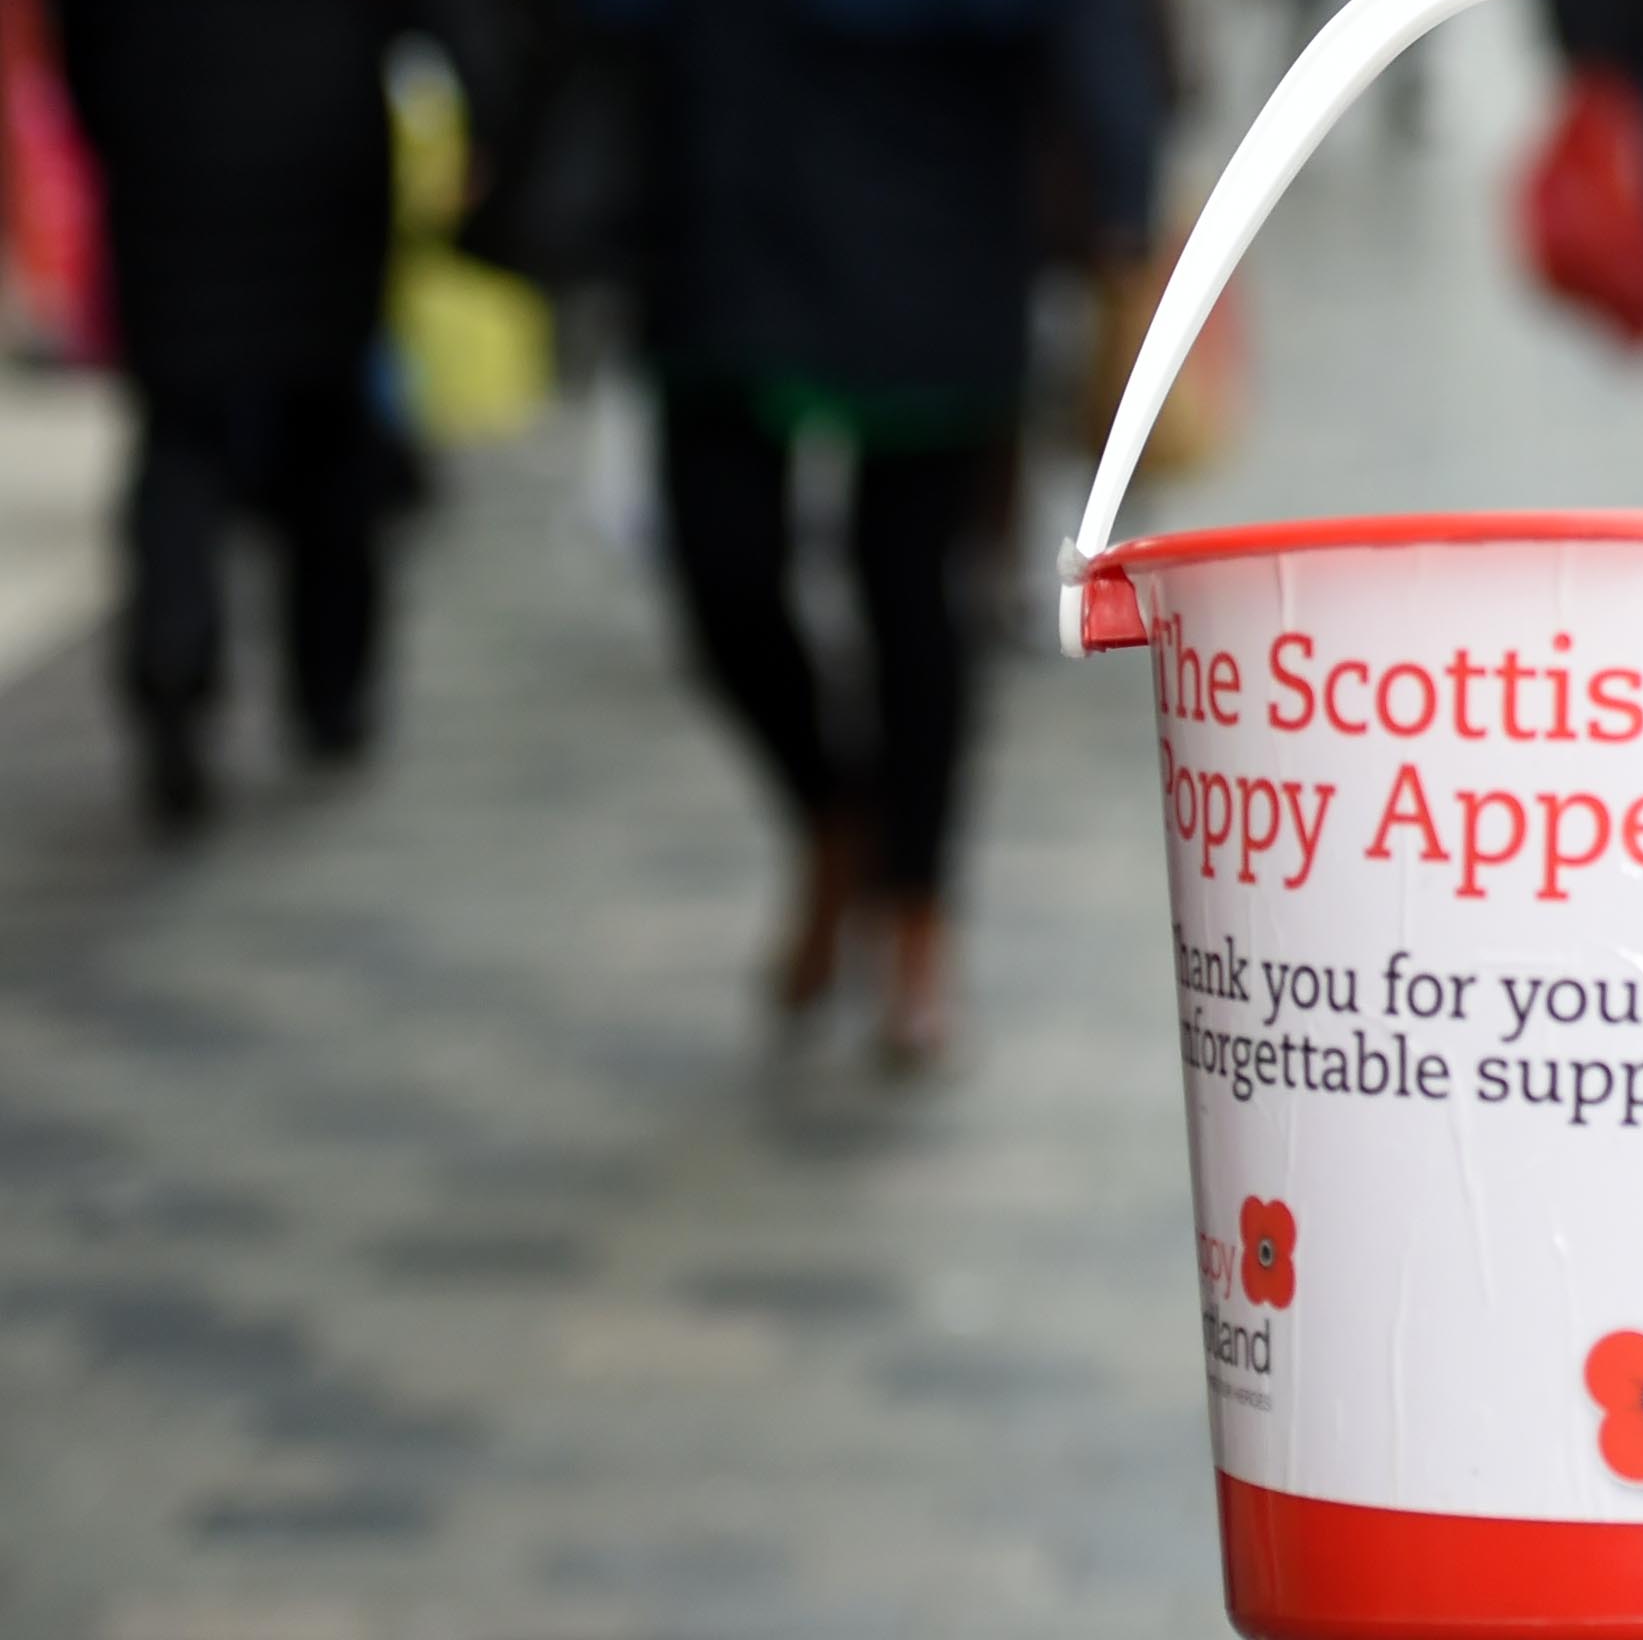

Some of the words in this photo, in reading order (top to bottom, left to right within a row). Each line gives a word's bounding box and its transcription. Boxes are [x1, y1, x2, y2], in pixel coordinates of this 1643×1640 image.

[1151, 612, 1241, 727] The
[1173, 924, 1250, 1002] hank
[1261, 960, 1359, 1027] you
[1383, 950, 1477, 1020] for
[1180, 1007, 1452, 1102] nforgettable
